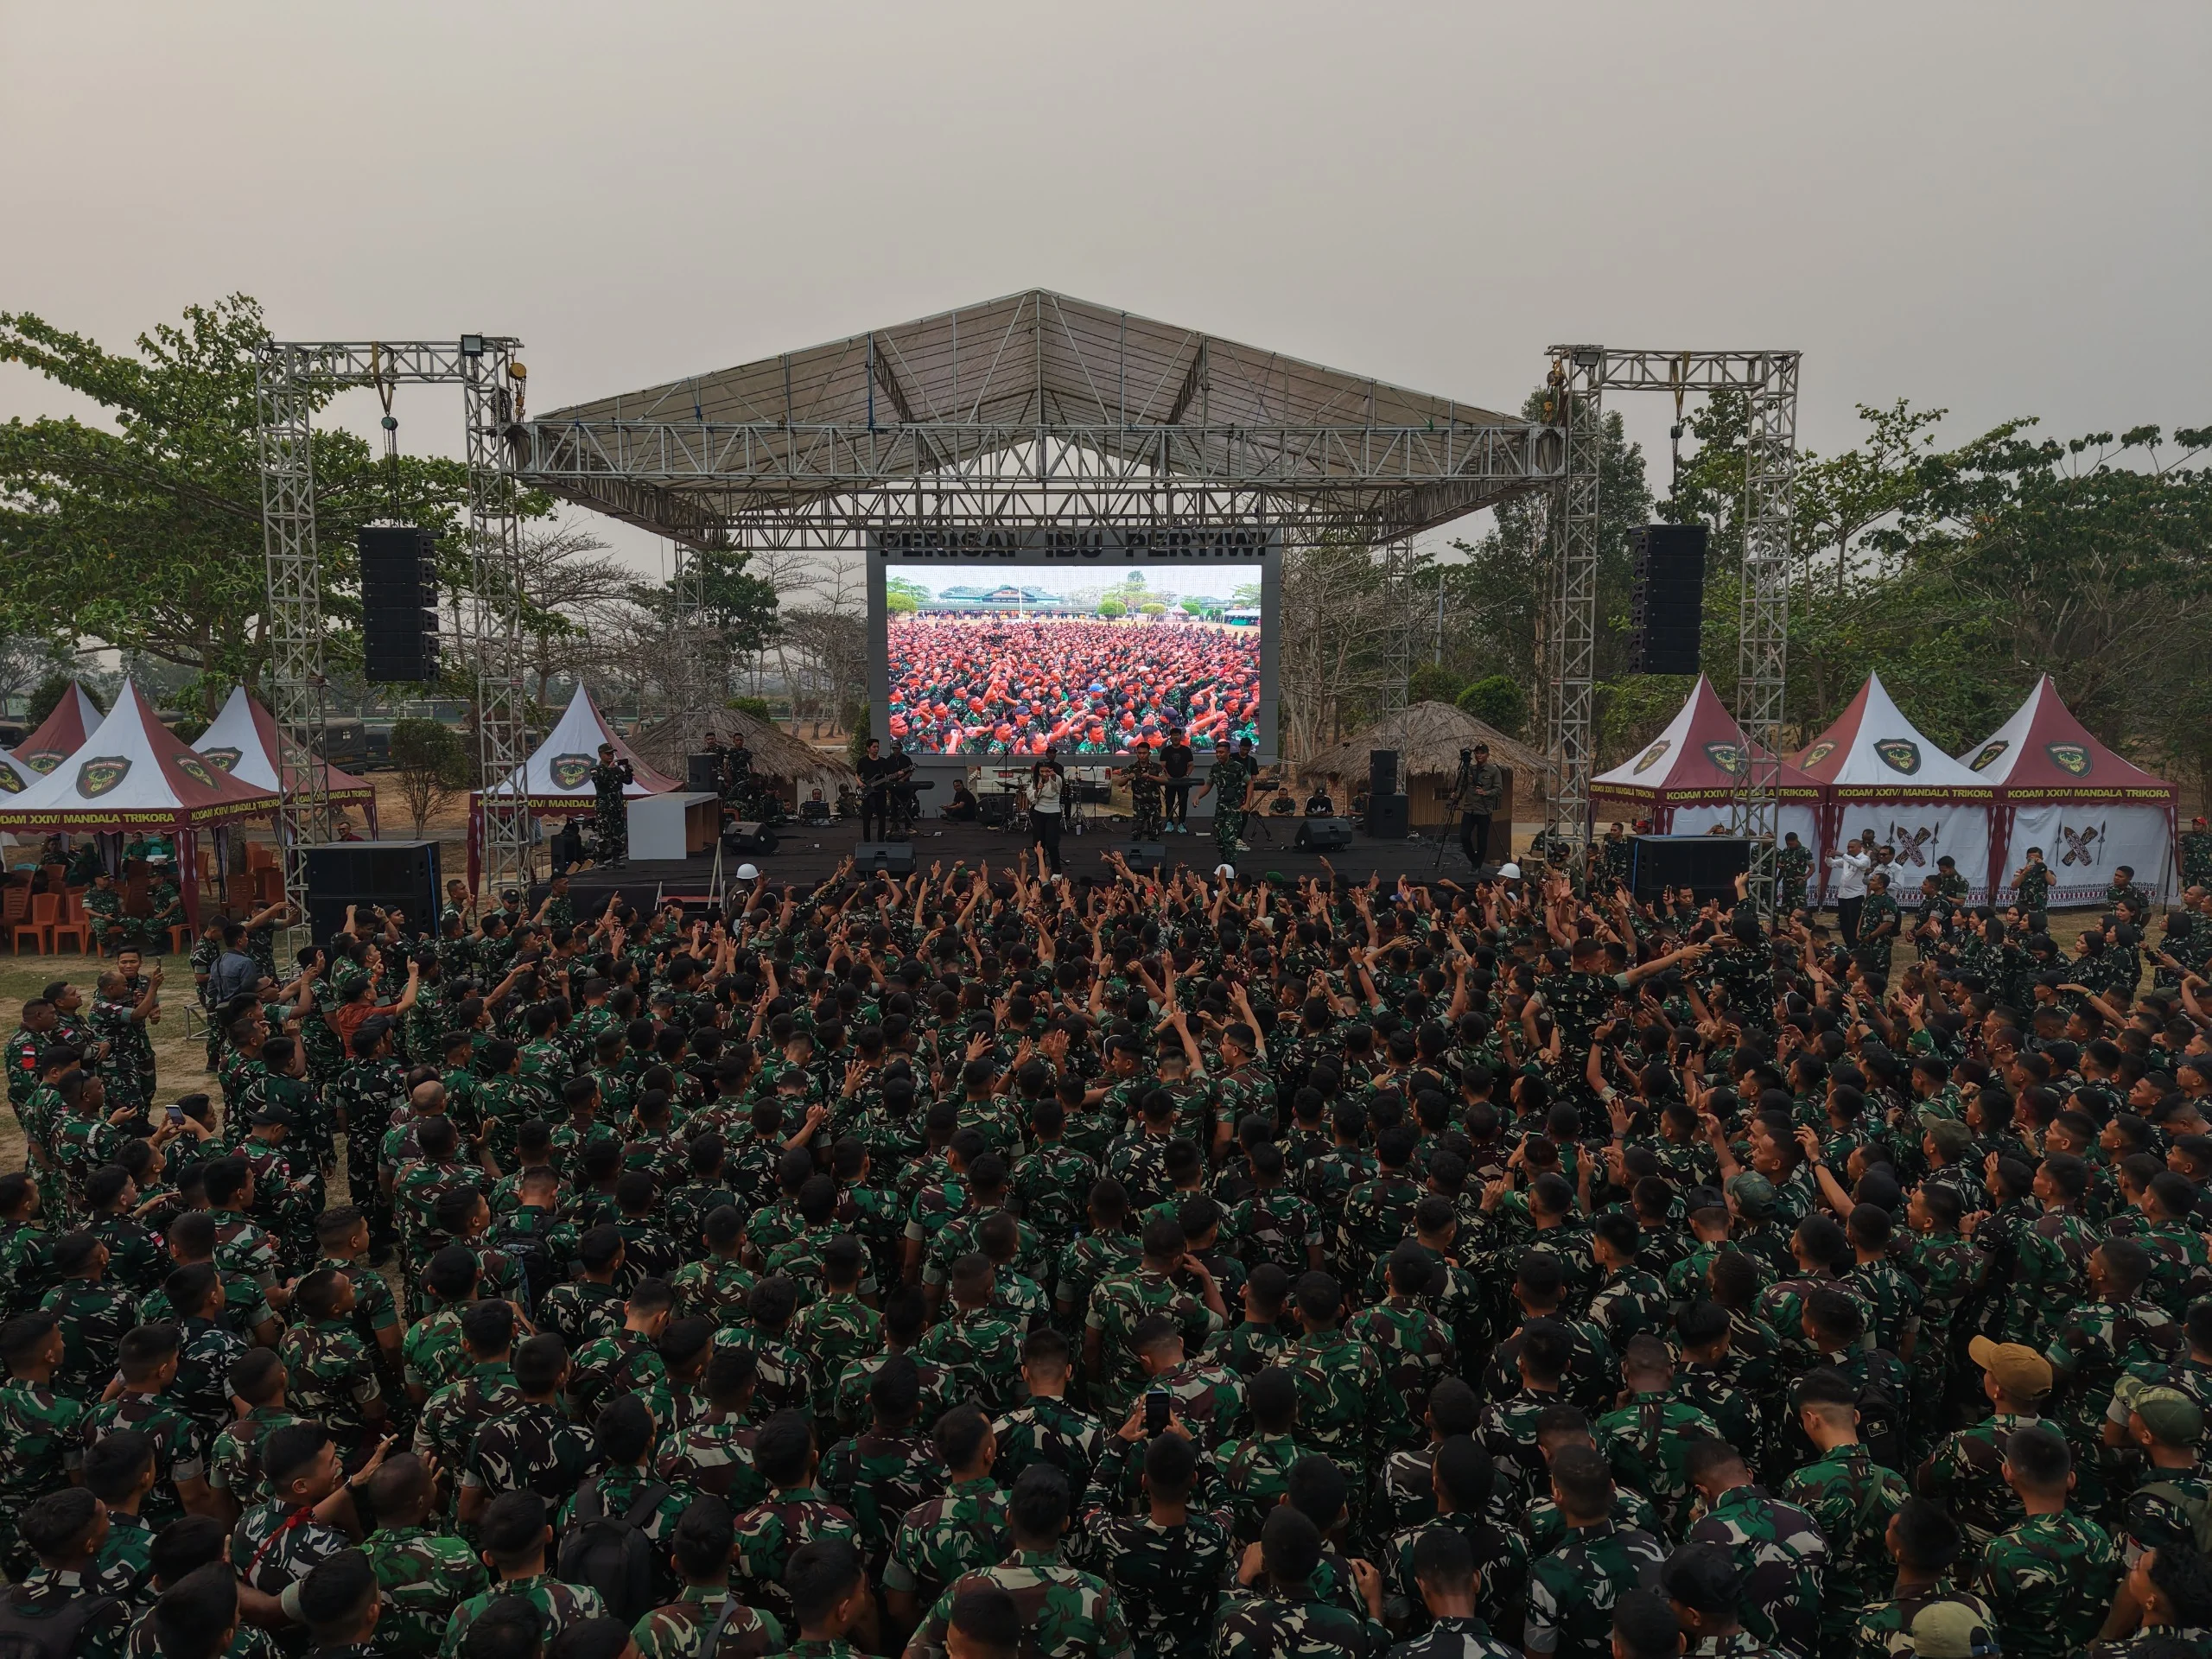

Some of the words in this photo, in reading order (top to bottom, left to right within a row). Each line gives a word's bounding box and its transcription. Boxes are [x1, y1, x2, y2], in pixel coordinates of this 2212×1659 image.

[880, 533, 1015, 556] PERISAI
[1046, 533, 1103, 557] IBU
[1126, 533, 1267, 556] PERTIWI
[1666, 791, 1701, 800] KODAM
[1778, 788, 1819, 798] TRIKORA
[1875, 788, 1901, 797] XXIV/
[1903, 788, 1949, 798] MANDALA
[1952, 789, 1993, 798] TRIKORA
[2007, 790, 2044, 798] KODAM
[2046, 789, 2072, 798] XXIV/
[2074, 789, 2123, 798] MANDALA
[2126, 789, 2171, 798] TRIKORA
[0, 815, 27, 824] DAM
[29, 815, 61, 824] XXIV/
[63, 814, 121, 823] MANDALA
[123, 813, 175, 823] TRIKORA
